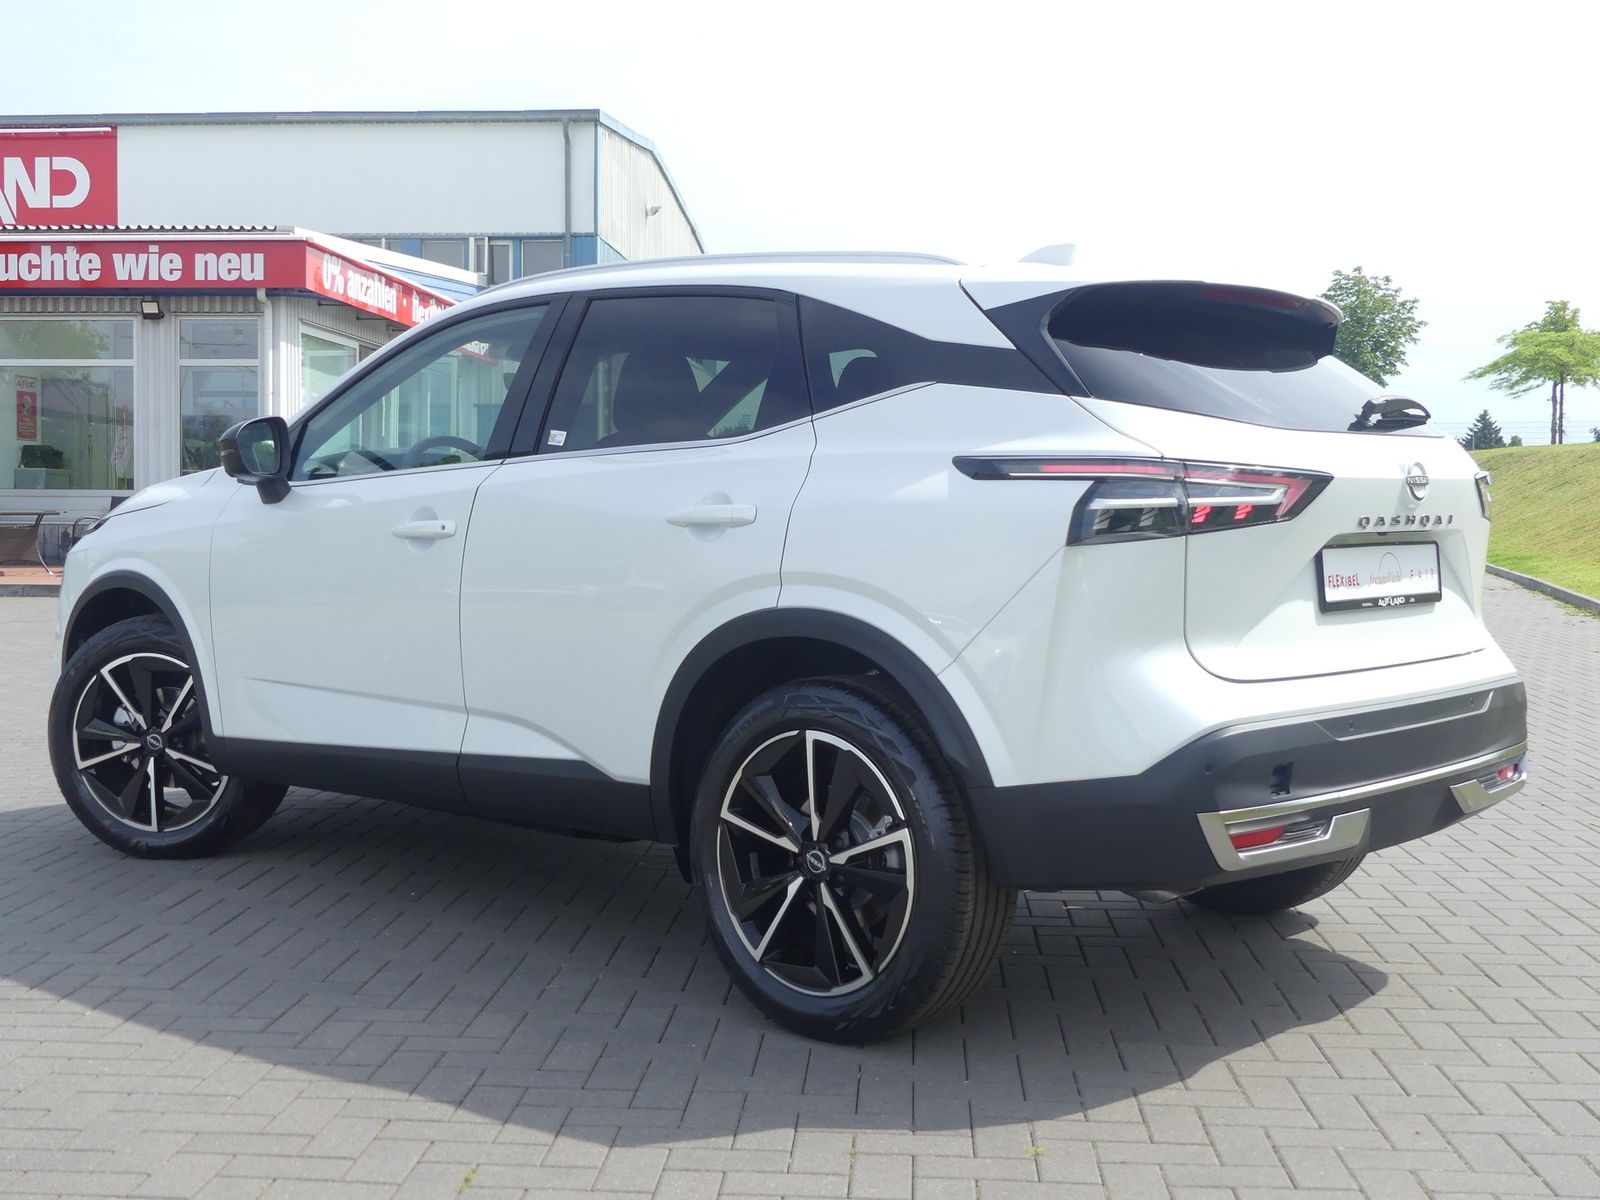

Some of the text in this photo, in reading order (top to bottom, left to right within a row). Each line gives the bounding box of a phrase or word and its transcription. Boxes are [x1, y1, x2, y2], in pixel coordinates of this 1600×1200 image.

[112, 244, 183, 281] wie
[194, 252, 264, 281] neu
[322, 253, 345, 296] 0%
[346, 268, 397, 315] anzahlen
[1358, 514, 1453, 529] QASHQAI
[1328, 573, 1360, 588] FLEXIBEL
[1410, 568, 1436, 581] FAIR
